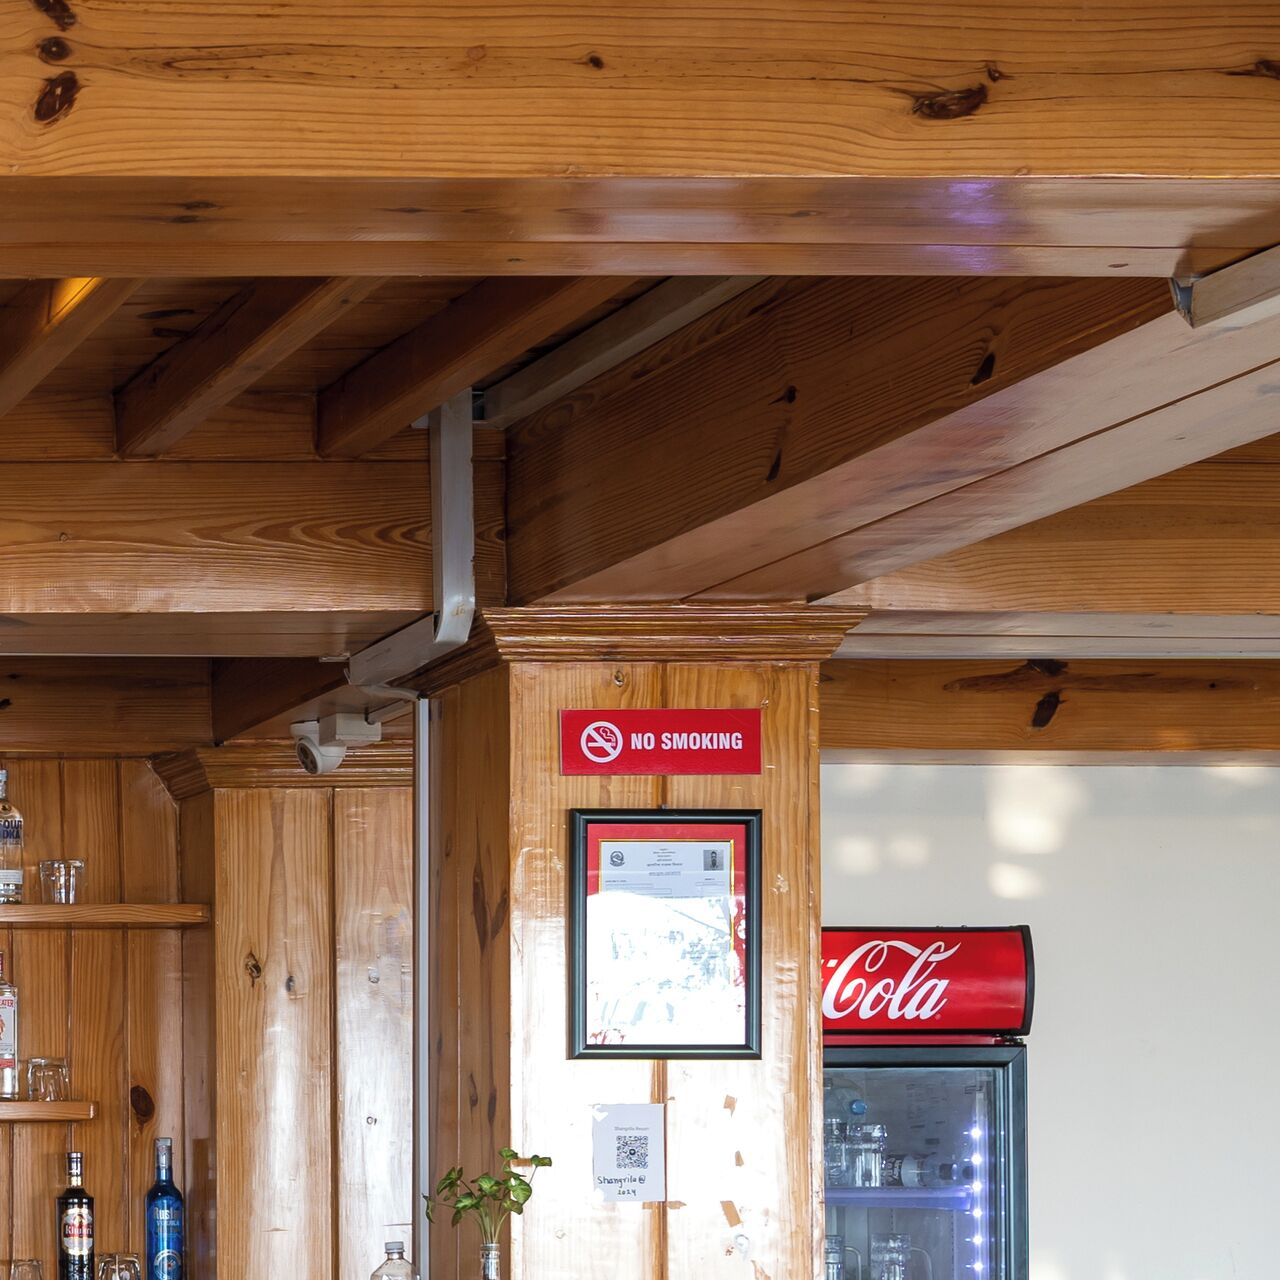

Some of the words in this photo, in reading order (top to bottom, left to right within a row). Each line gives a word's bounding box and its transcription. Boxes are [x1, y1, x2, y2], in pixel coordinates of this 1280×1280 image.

[631, 732, 655, 750] NO
[661, 732, 743, 750] SMOKING
[617, 1189, 637, 1197] 2024
